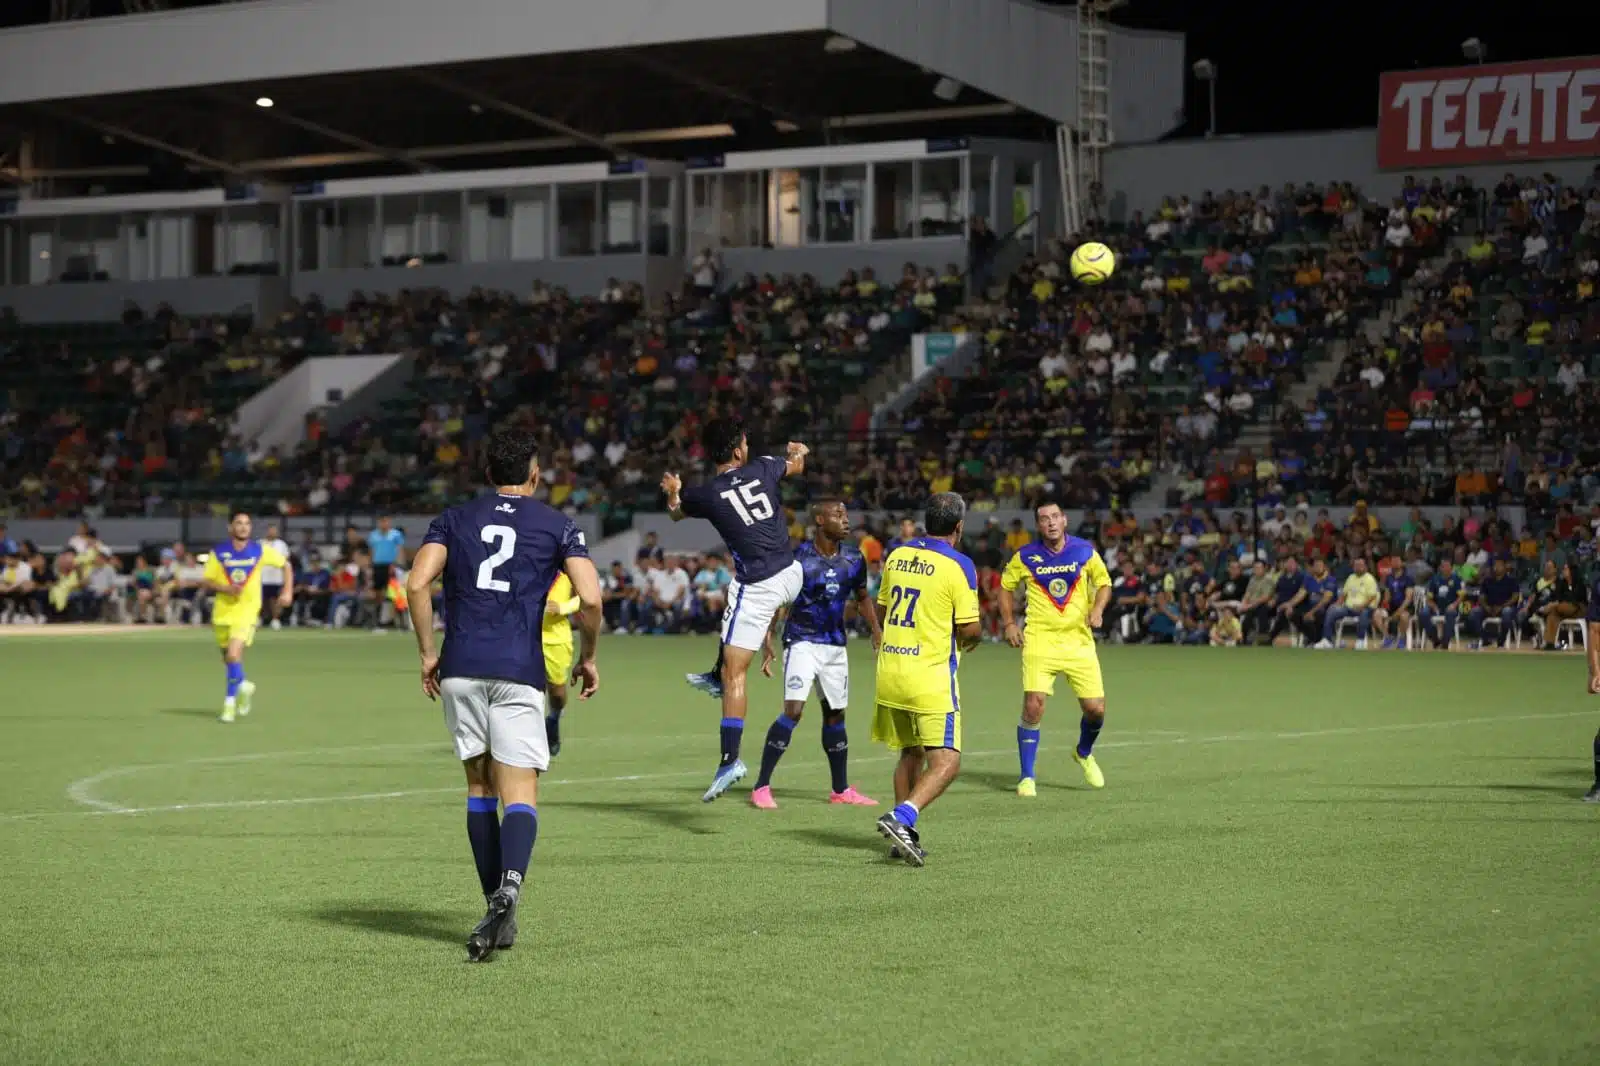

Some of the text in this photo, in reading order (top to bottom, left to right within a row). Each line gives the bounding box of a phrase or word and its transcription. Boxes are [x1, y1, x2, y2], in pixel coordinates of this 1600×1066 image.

[1392, 68, 1600, 151] TECATE
[720, 479, 774, 526] 15
[476, 524, 517, 592] 2
[1036, 562, 1077, 575] Concord
[888, 585, 921, 628] 27
[882, 642, 920, 656] Concord
